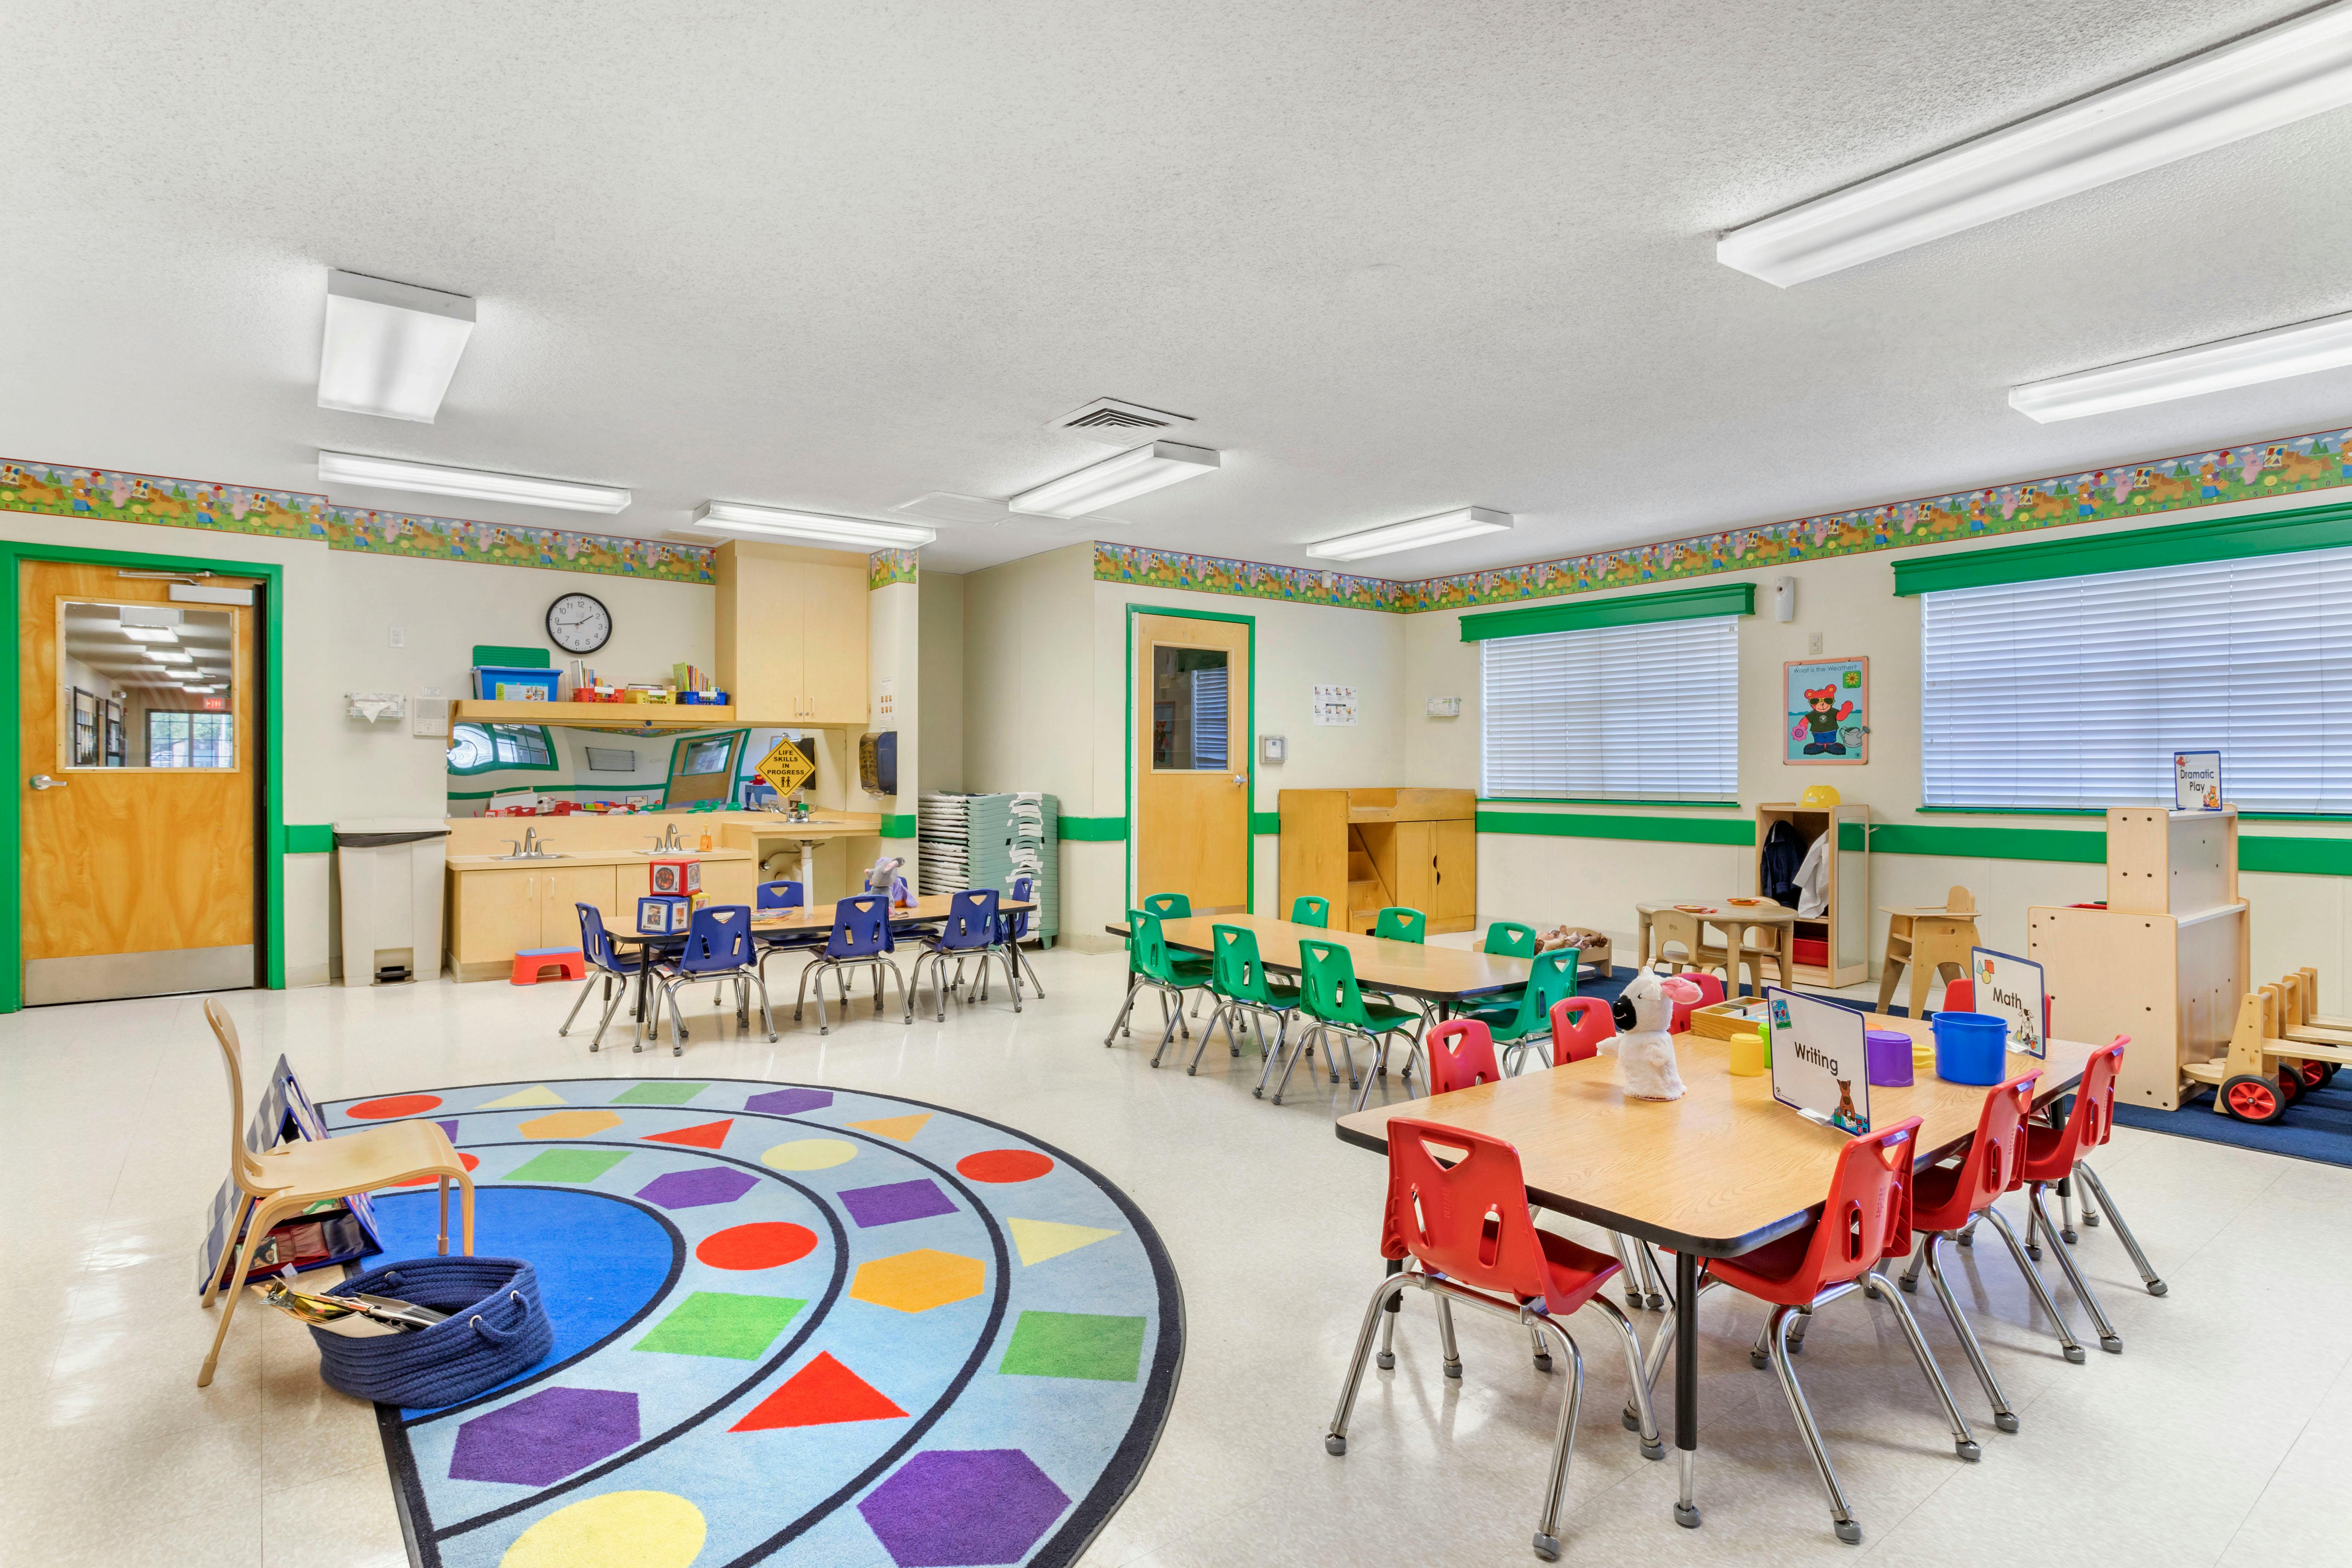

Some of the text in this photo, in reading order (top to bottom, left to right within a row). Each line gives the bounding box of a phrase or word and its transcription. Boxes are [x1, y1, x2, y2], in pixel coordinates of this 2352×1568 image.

[2180, 769, 2214, 779] Dramatic
[2190, 782, 2205, 793] Play
[1993, 987, 2022, 1009] Math
[1794, 1041, 1838, 1076] Writing
